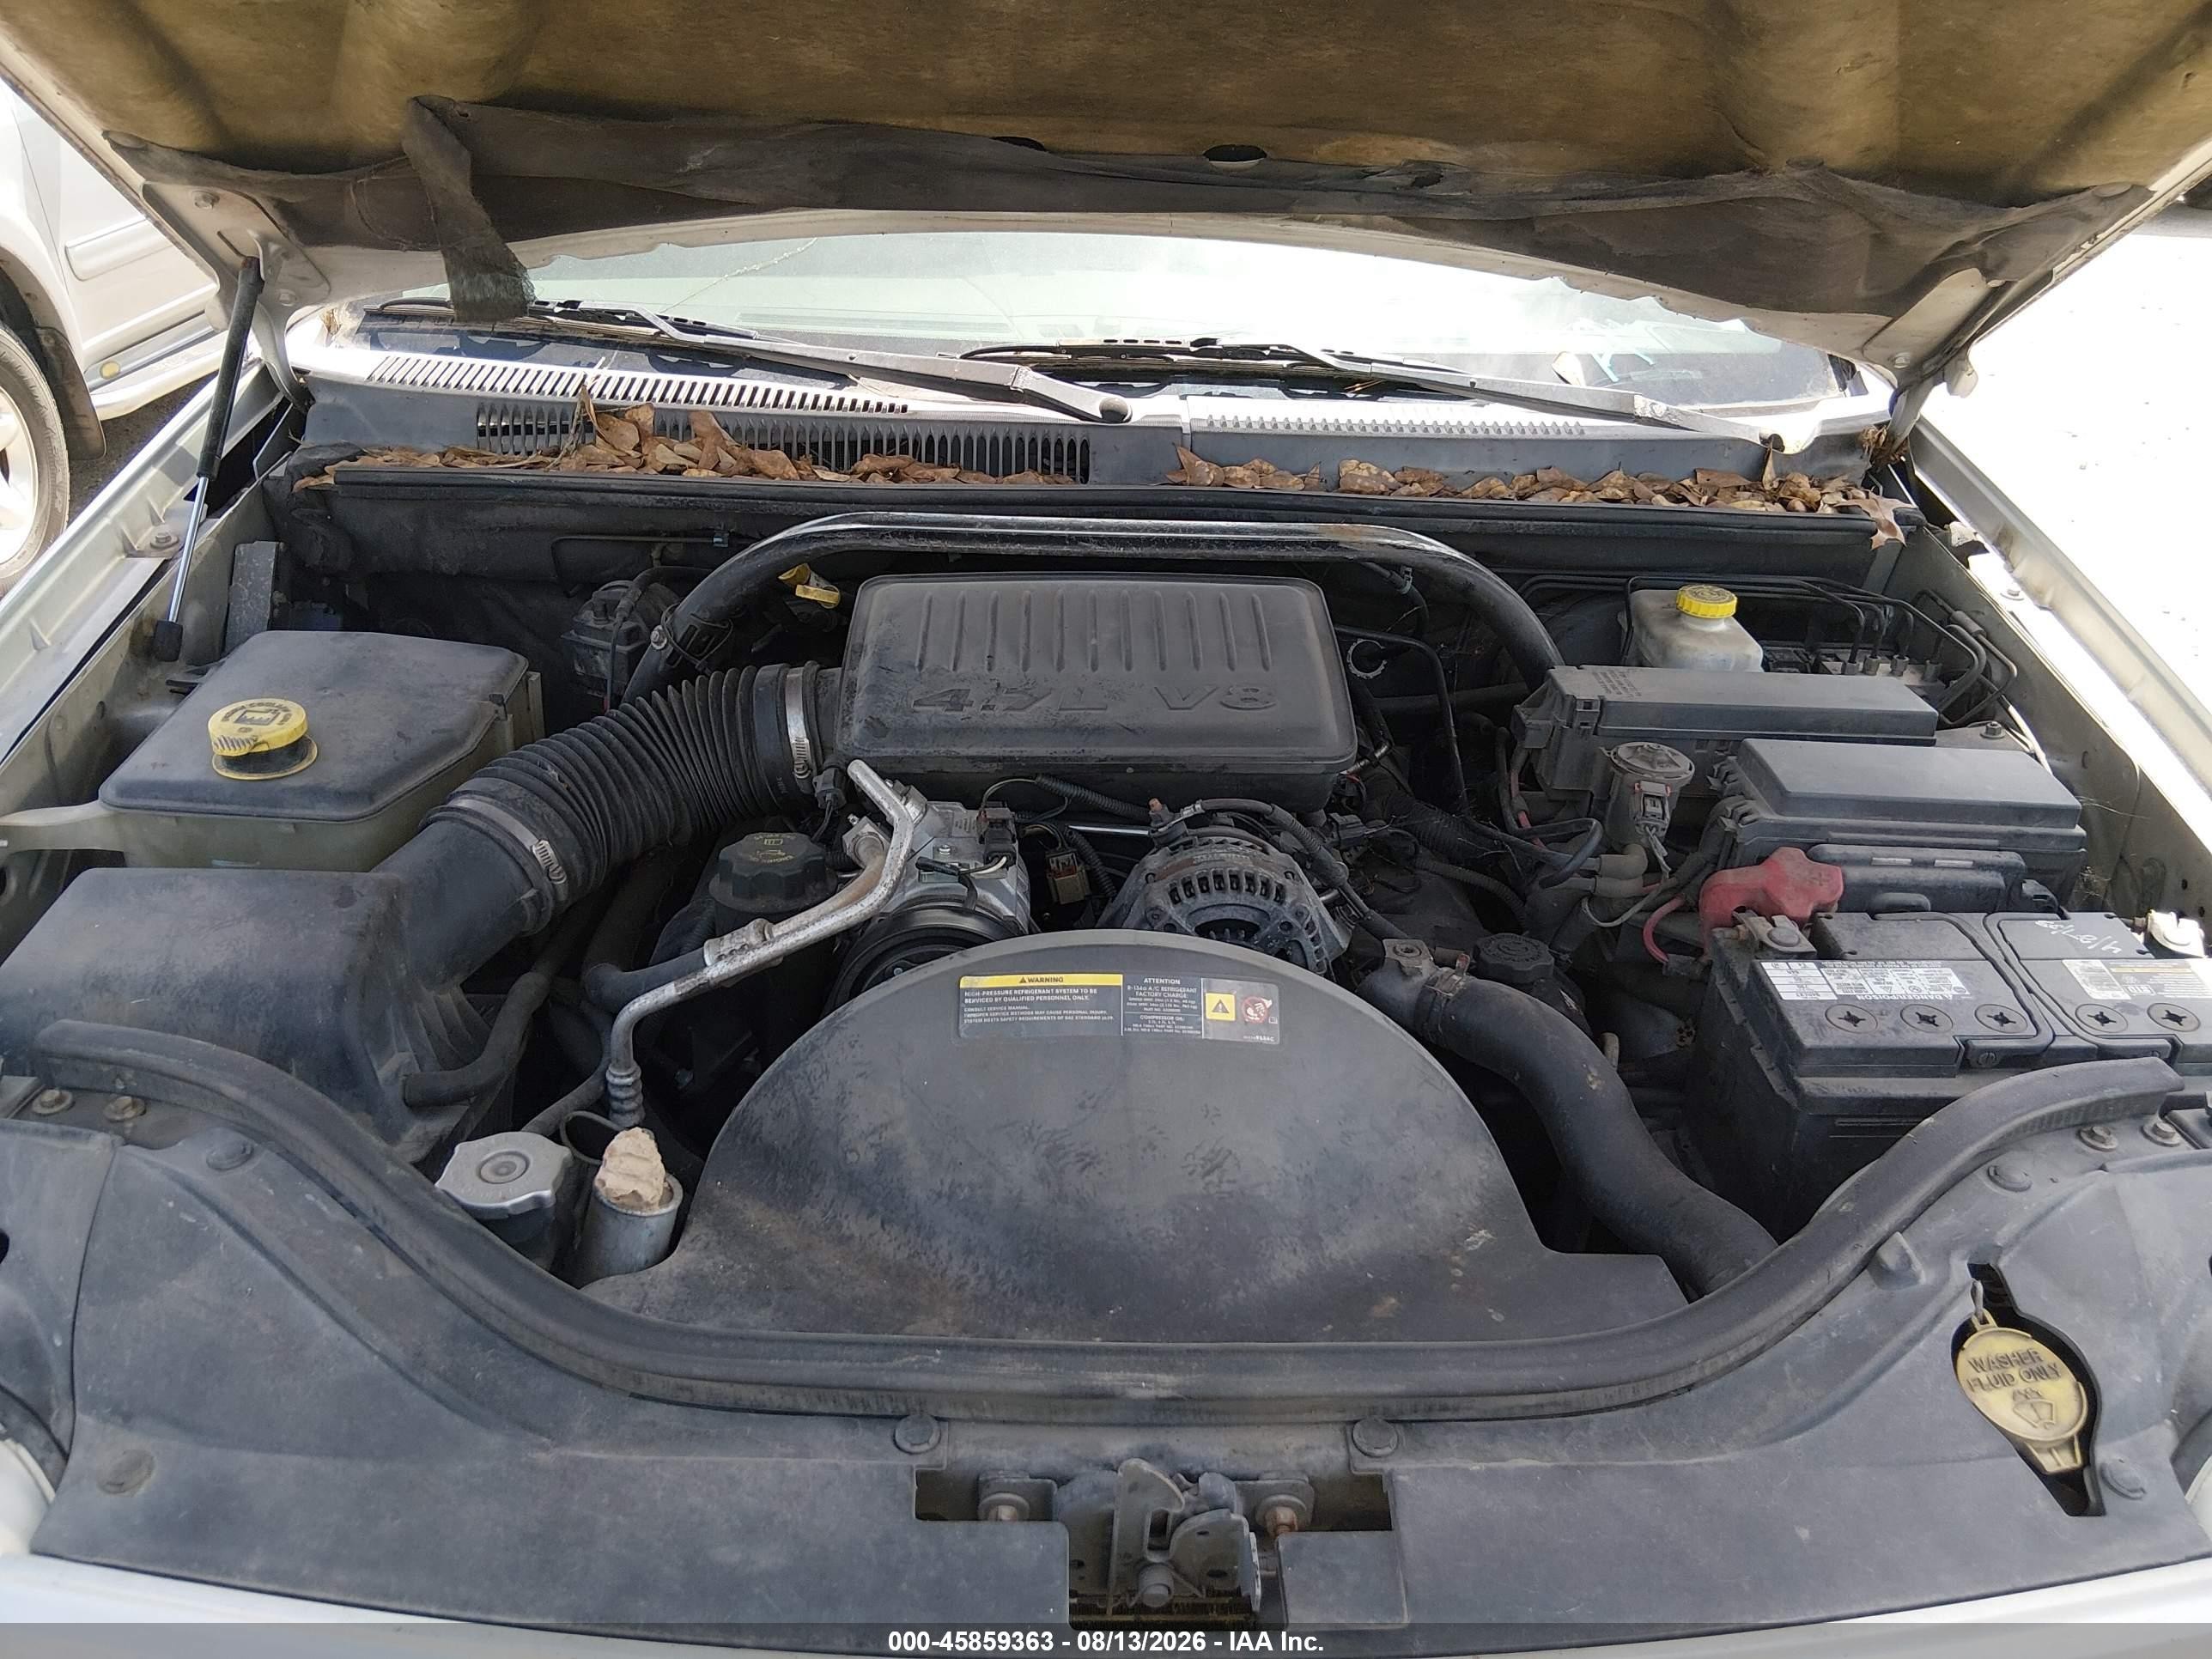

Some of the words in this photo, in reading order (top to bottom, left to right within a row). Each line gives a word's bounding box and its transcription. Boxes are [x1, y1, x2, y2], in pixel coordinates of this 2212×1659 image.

[913, 686, 1108, 712] 4.7L
[1154, 684, 1279, 711] V8
[1967, 1348, 2044, 1373] WASHER
[1966, 1373, 2016, 1393] FLUID
[2019, 1362, 2061, 1383] ONLY
